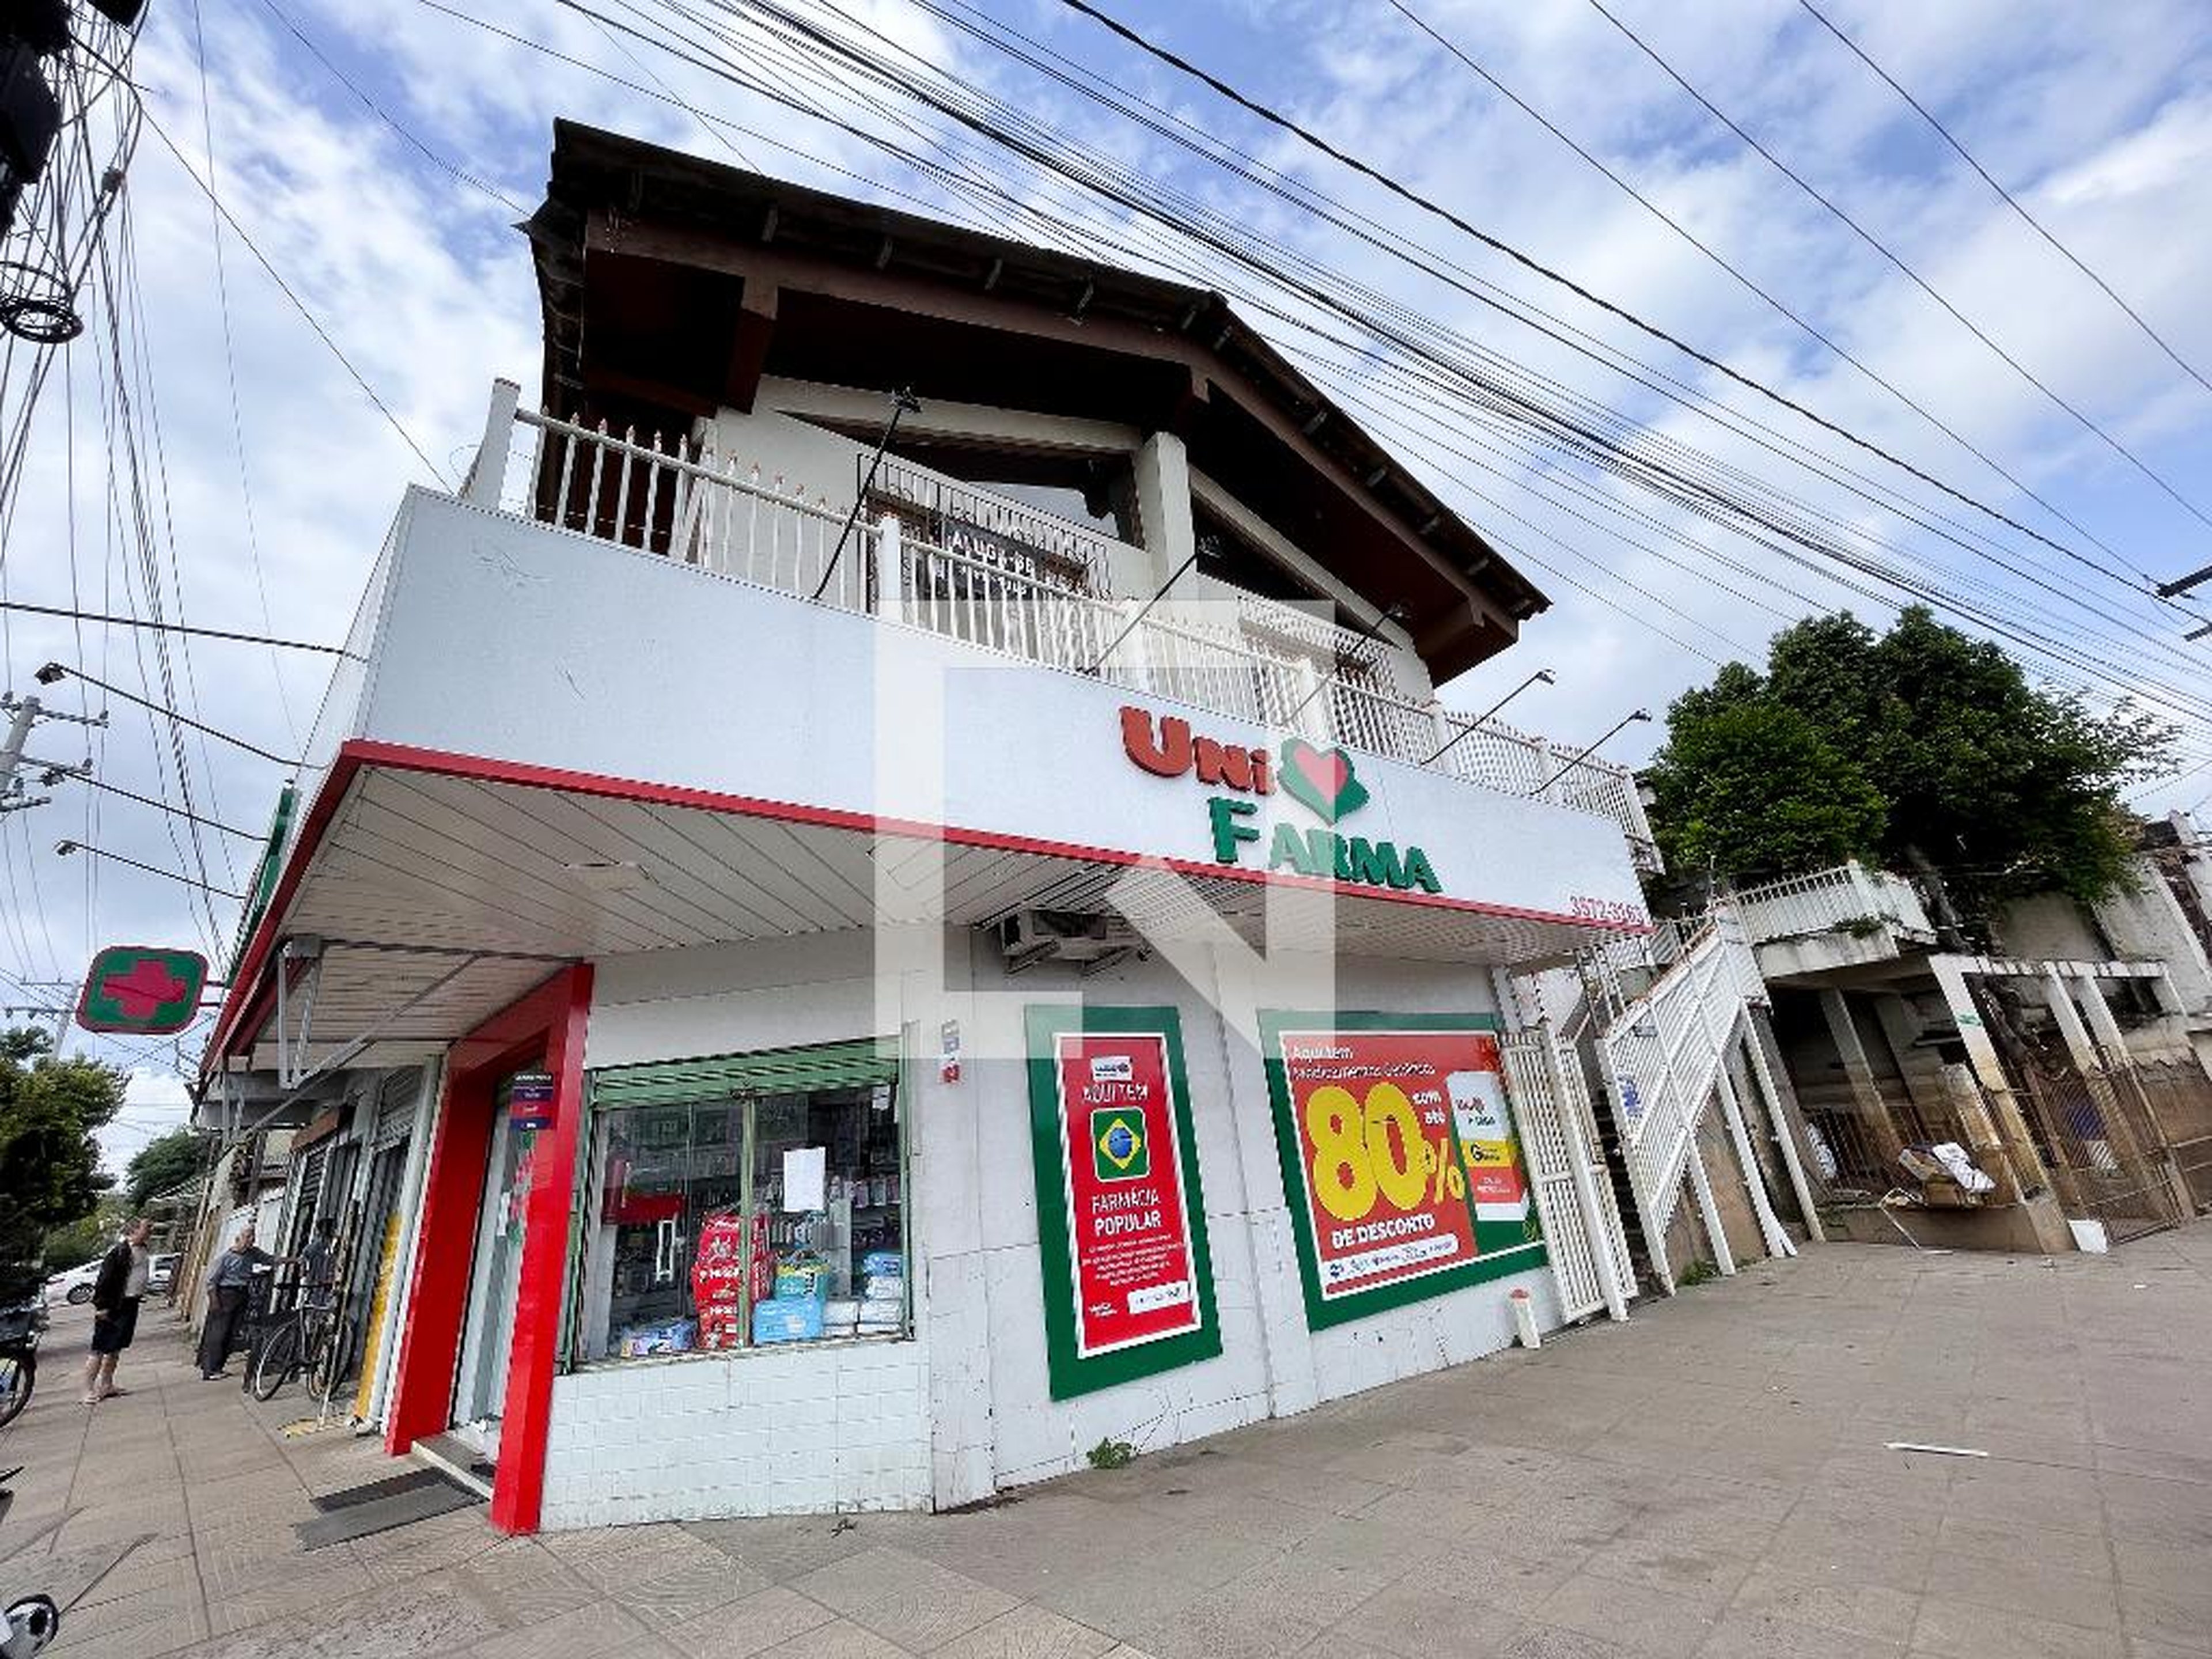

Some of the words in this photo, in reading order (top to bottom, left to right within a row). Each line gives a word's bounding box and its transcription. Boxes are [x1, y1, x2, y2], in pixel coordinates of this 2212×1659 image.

[1207, 796, 1442, 893] FARMA
[1306, 1082, 1465, 1221] 80%
[1094, 1210, 1162, 1237] POPULAR
[1332, 1228, 1355, 1249] DE
[1356, 1212, 1435, 1243] DESCONTO
